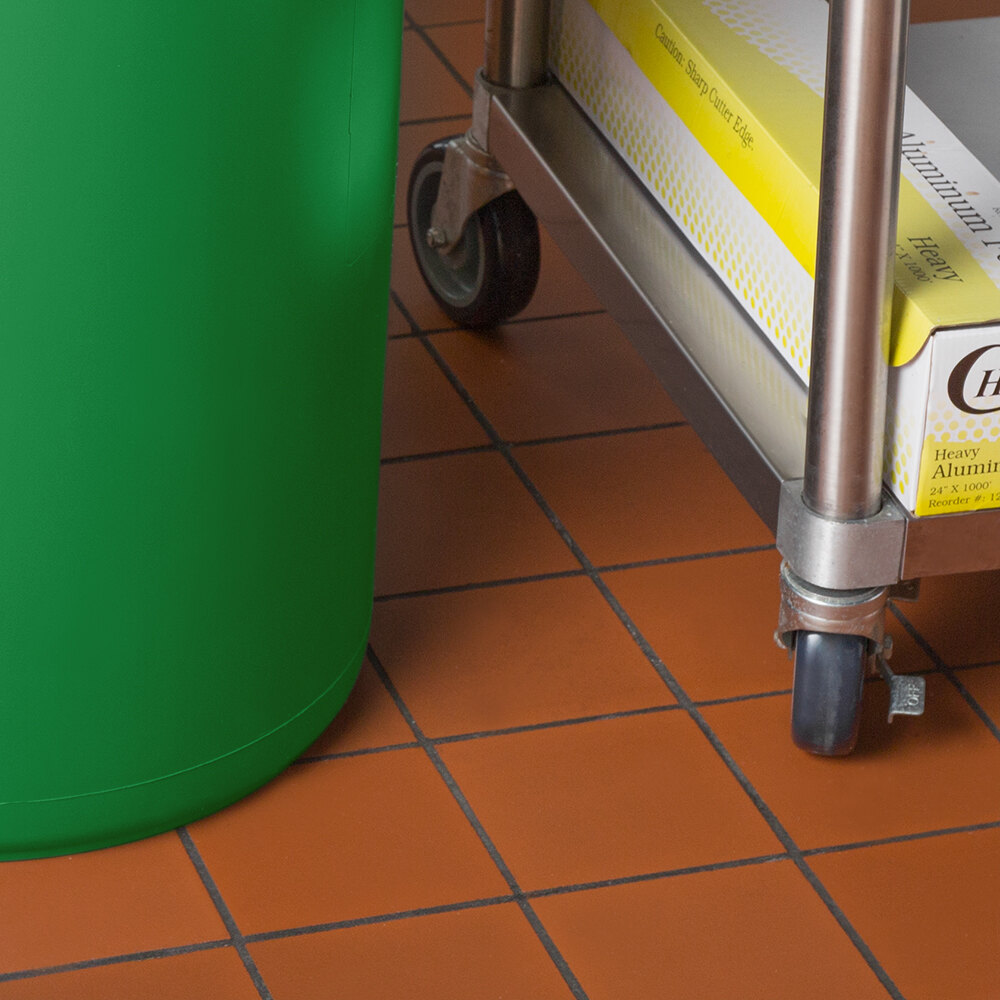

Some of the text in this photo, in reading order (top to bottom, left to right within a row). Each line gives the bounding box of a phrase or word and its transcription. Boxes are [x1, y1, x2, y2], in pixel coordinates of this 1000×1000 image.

[655, 23, 755, 151] Caution: Sharp Cutter Edge.
[906, 236, 964, 283] Heavy
[934, 448, 981, 461] Heavy
[951, 484, 960, 493] X
[928, 496, 971, 509] Reorder
